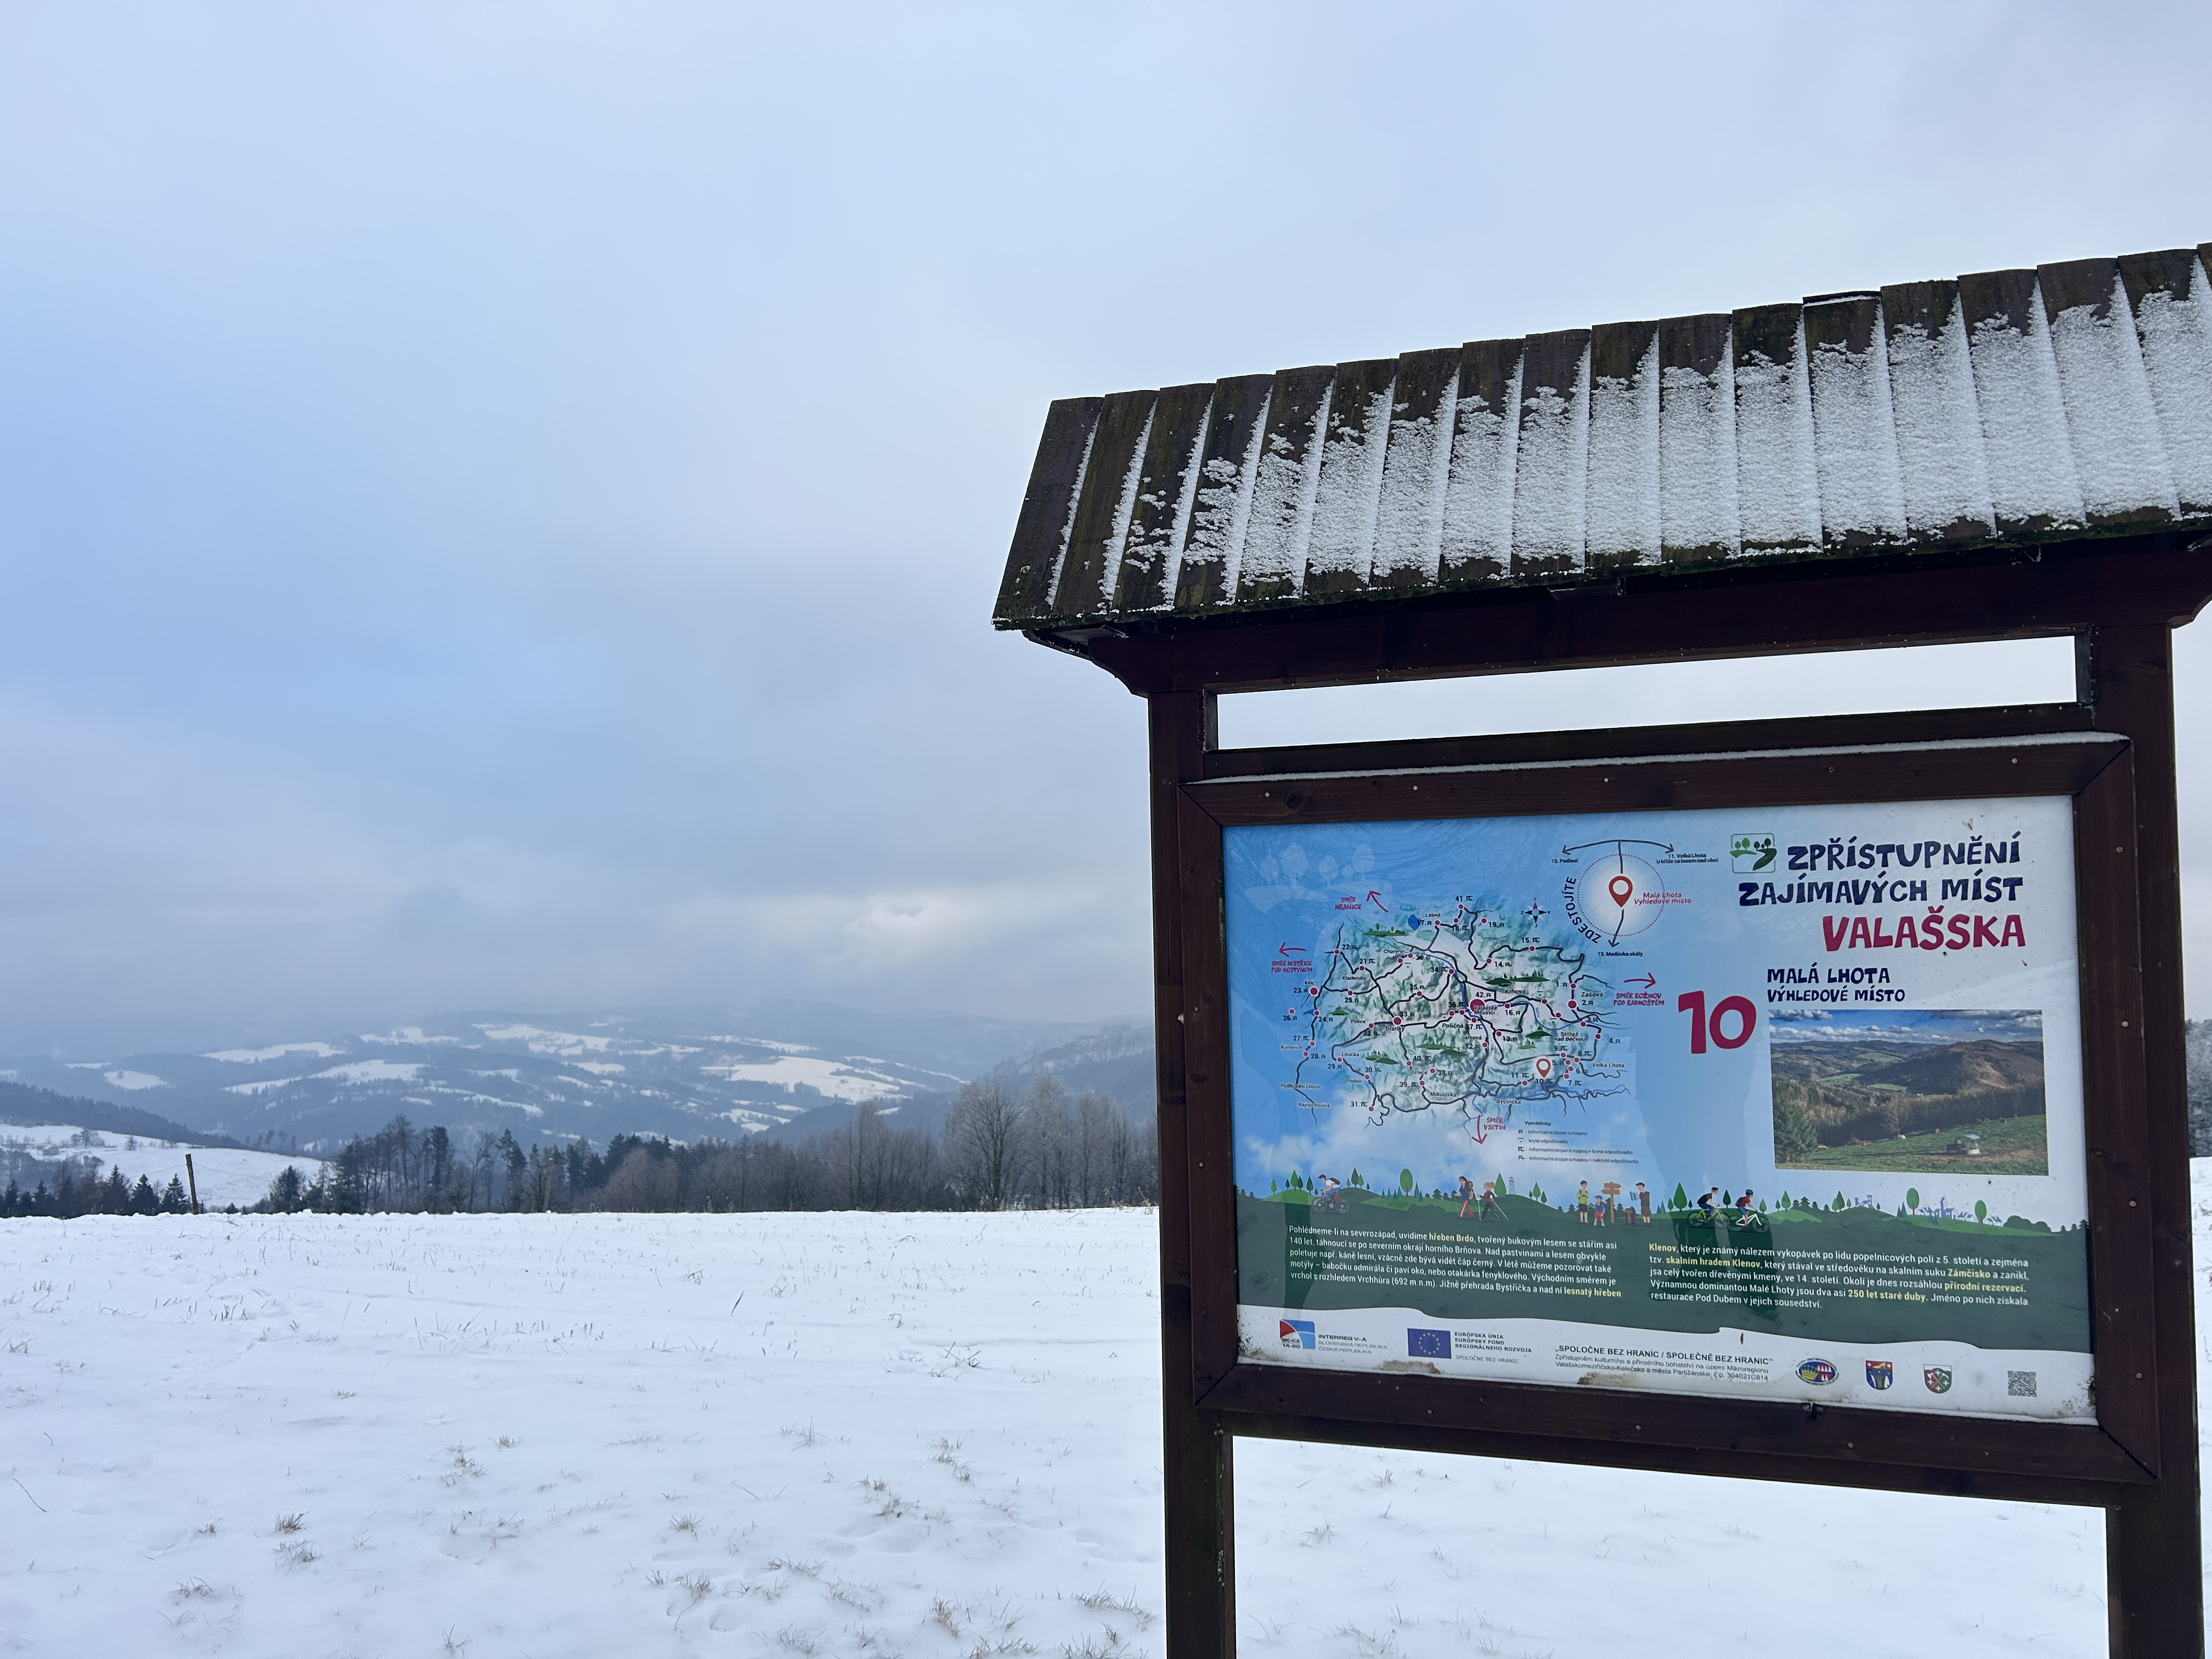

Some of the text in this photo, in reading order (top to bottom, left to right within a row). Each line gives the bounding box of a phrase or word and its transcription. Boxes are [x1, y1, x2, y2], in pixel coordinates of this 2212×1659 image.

[1788, 831, 2021, 871] ZPŘÍSTUPNĚNÍ
[1739, 868, 2023, 906] ZAJÍMAVÝCH MÍST
[1634, 898, 1670, 906] Výhledové
[1822, 905, 2025, 951] VALAŠSKA
[1767, 962, 1890, 984] MALÁ LHOTA
[1767, 985, 1905, 1002] VÝHLEDOVÉ MÍSTO
[1678, 991, 1757, 1054] 10
[1289, 1224, 1339, 1235] Pohlédneme-li
[1350, 1229, 1397, 1239] severozápad,
[1398, 1231, 1427, 1240] uvidíme
[1429, 1232, 1454, 1242] hřeben
[1456, 1233, 1476, 1243] Brdo,
[1477, 1235, 1506, 1245] tvořený
[1507, 1235, 1542, 1247] bukovým
[1543, 1237, 1566, 1247] lesem
[1578, 1240, 1604, 1249] stářím
[1605, 1240, 1617, 1249] asi
[1289, 1236, 1302, 1245] 140
[1304, 1237, 1314, 1246] let,
[1316, 1238, 1347, 1248] táhnoucí
[1358, 1242, 1367, 1250] po
[1368, 1242, 1401, 1250] severním
[1425, 1243, 1453, 1253] horního
[1485, 1246, 1500, 1255] Nad
[1502, 1248, 1543, 1257] pastvinami
[1551, 1249, 1575, 1259] lesem
[1576, 1251, 1606, 1262] obvykle
[1290, 1248, 1611, 1273] poletuje např. káně lesní, vzácně zde bývá vidět čáp černý. V létě můžeme pozorovat také
[1649, 1243, 1679, 1253] Klenov,
[1680, 1244, 1701, 1255] který
[1702, 1244, 1710, 1255] je
[1711, 1245, 1739, 1256] známý
[1740, 1246, 1775, 1256] nálezem
[1776, 1248, 1821, 1259] vykopávek
[1822, 1252, 1833, 1261] po
[1835, 1250, 1851, 1260] lidu
[1853, 1252, 1915, 1264] popelnicových
[1917, 1254, 1933, 1265] polí
[1943, 1255, 1950, 1264] 5.
[1953, 1256, 1982, 1265] století
[1991, 1258, 2028, 1268] zejména
[1666, 1255, 1698, 1265] skalním
[1699, 1256, 1730, 1266] hradem
[1732, 1258, 1763, 1269] Klenov,
[1764, 1260, 1785, 1271] který
[1787, 1261, 1813, 1271] stával
[1826, 1263, 1874, 1273] středověku
[1888, 1265, 1922, 1276] skalním
[1925, 1267, 1945, 1277] suku
[2000, 1271, 2029, 1280] zanikl,
[1649, 1267, 1662, 1277] jsa
[1663, 1267, 1680, 1278] celý
[1681, 1268, 1707, 1278] tvořen
[1709, 1269, 1751, 1281] dřevěnými
[1753, 1271, 1783, 1283] kmeny,
[1797, 1274, 1809, 1283] 14.
[1811, 1275, 1841, 1284] století.
[1843, 1276, 1865, 1285] Okolí
[1867, 1277, 1875, 1288] je
[1876, 1277, 1897, 1287] dnes
[1899, 1279, 1943, 1289] rozsáhlou
[1944, 1280, 1980, 1291] přírodní
[1982, 1284, 2026, 1293] rezervací.
[1650, 1279, 2028, 1305] Významnou dominantou Malé Lhoty jsou dva asi 250 let staré duby. Jméno po nich získala
[1626, 1349, 1658, 1358] HRANÍC
[1666, 1351, 1713, 1361] SPOLEČNĚ
